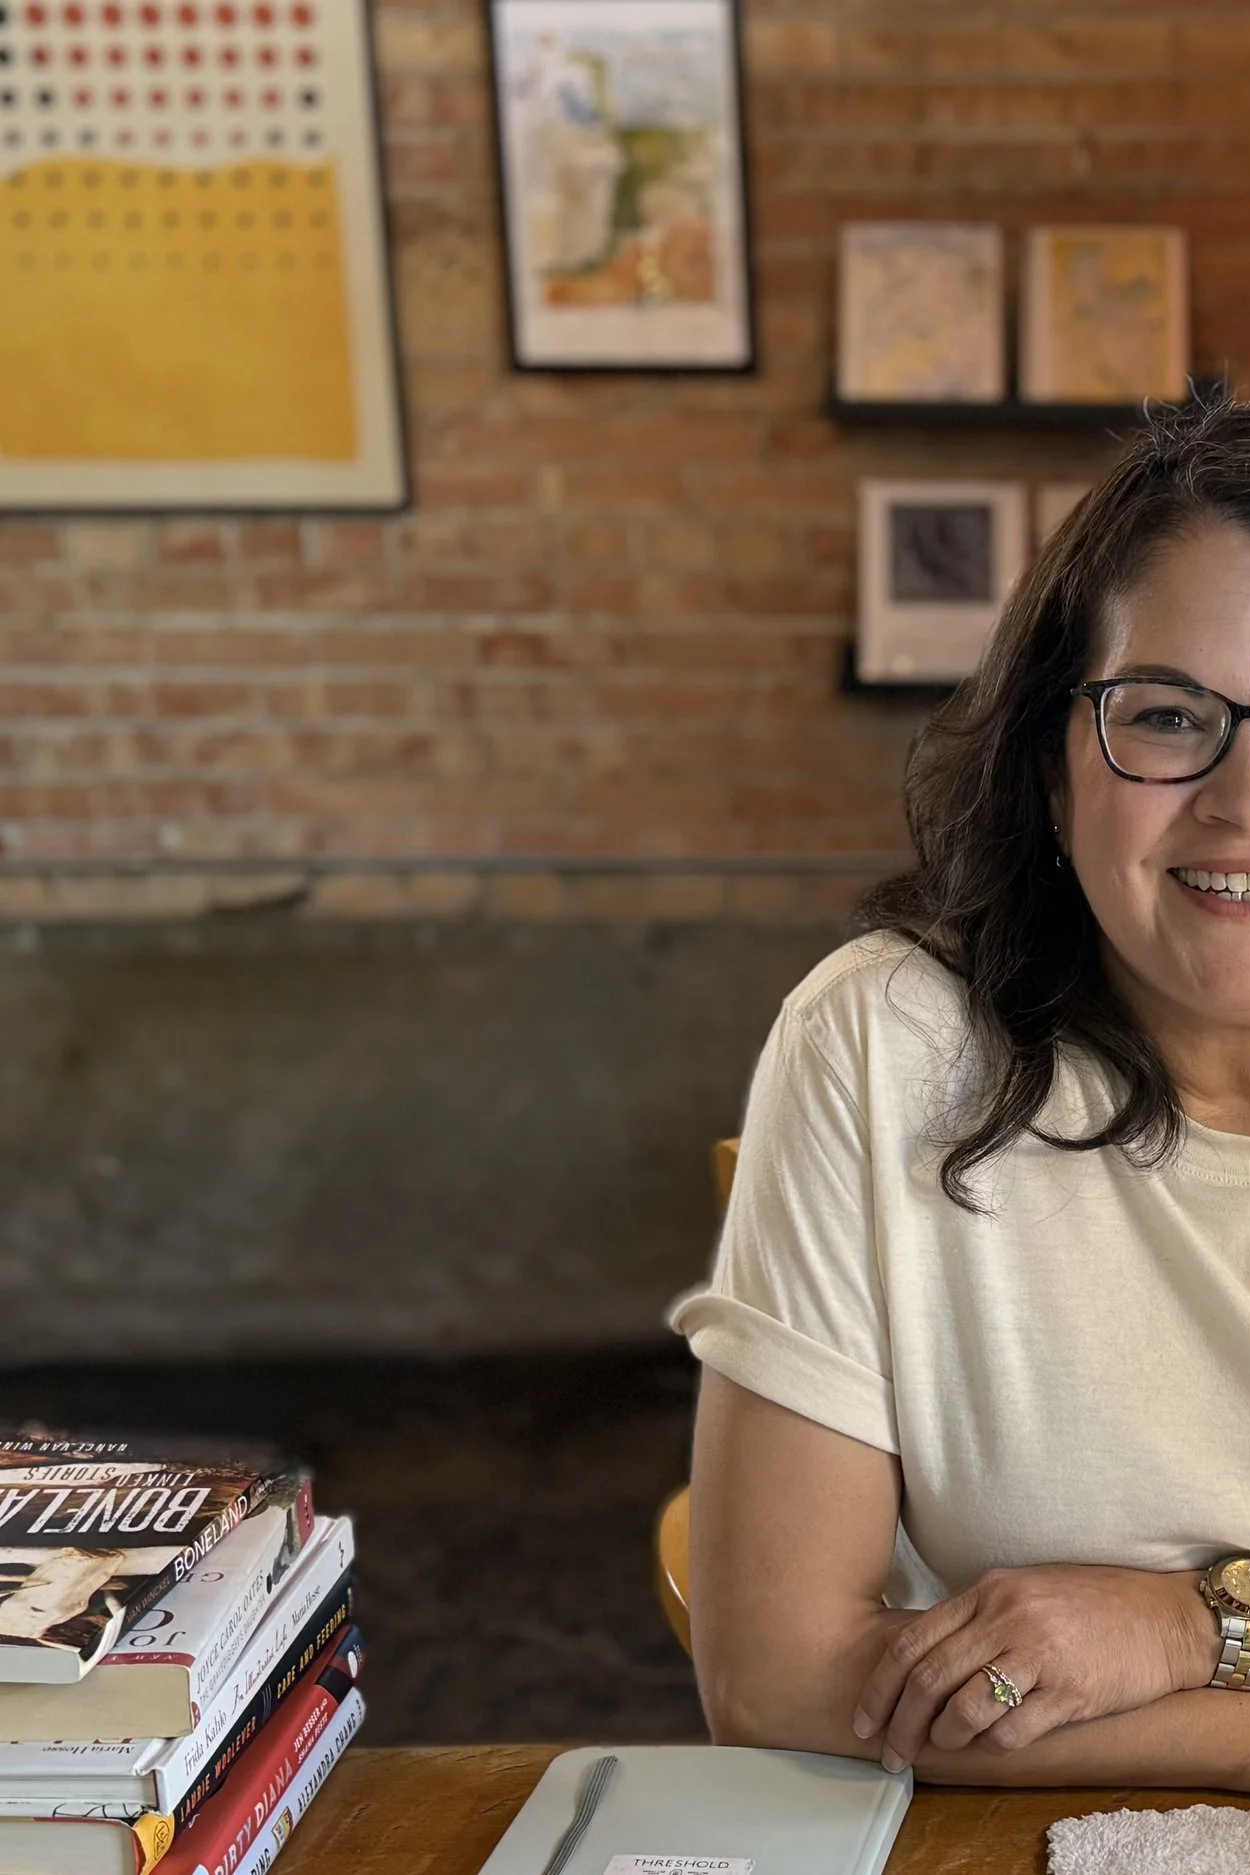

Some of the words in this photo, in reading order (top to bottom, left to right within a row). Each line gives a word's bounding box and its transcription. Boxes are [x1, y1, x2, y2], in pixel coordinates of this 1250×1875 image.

[0, 1441, 33, 1451] WIN
[40, 1442, 70, 1452] VAN
[78, 1443, 128, 1452] NANCE
[24, 1467, 116, 1480] STORIES
[116, 1473, 195, 1487] LINKED
[0, 1488, 211, 1533] BONELA
[174, 1495, 248, 1581] BONELAND
[196, 1642, 220, 1695] JOYCE
[220, 1606, 242, 1650] CAROL
[243, 1569, 265, 1613] OATES
[180, 1773, 211, 1823] LAURIE
[214, 1715, 257, 1779] WOOLEVER
[277, 1665, 297, 1699] CARE
[299, 1643, 314, 1672] AND
[316, 1604, 347, 1650] FEEDING
[302, 1707, 321, 1737] BESSER
[91, 1746, 135, 1755] Maria
[183, 1743, 205, 1777] Frida
[205, 1709, 228, 1751] Kahlo
[297, 1748, 335, 1814] ALEXANDRA
[335, 1712, 357, 1753] CHANG
[214, 1815, 252, 1875] DIRTY
[254, 1757, 293, 1828] DIANA
[634, 1858, 730, 1869] THRESHOLD
